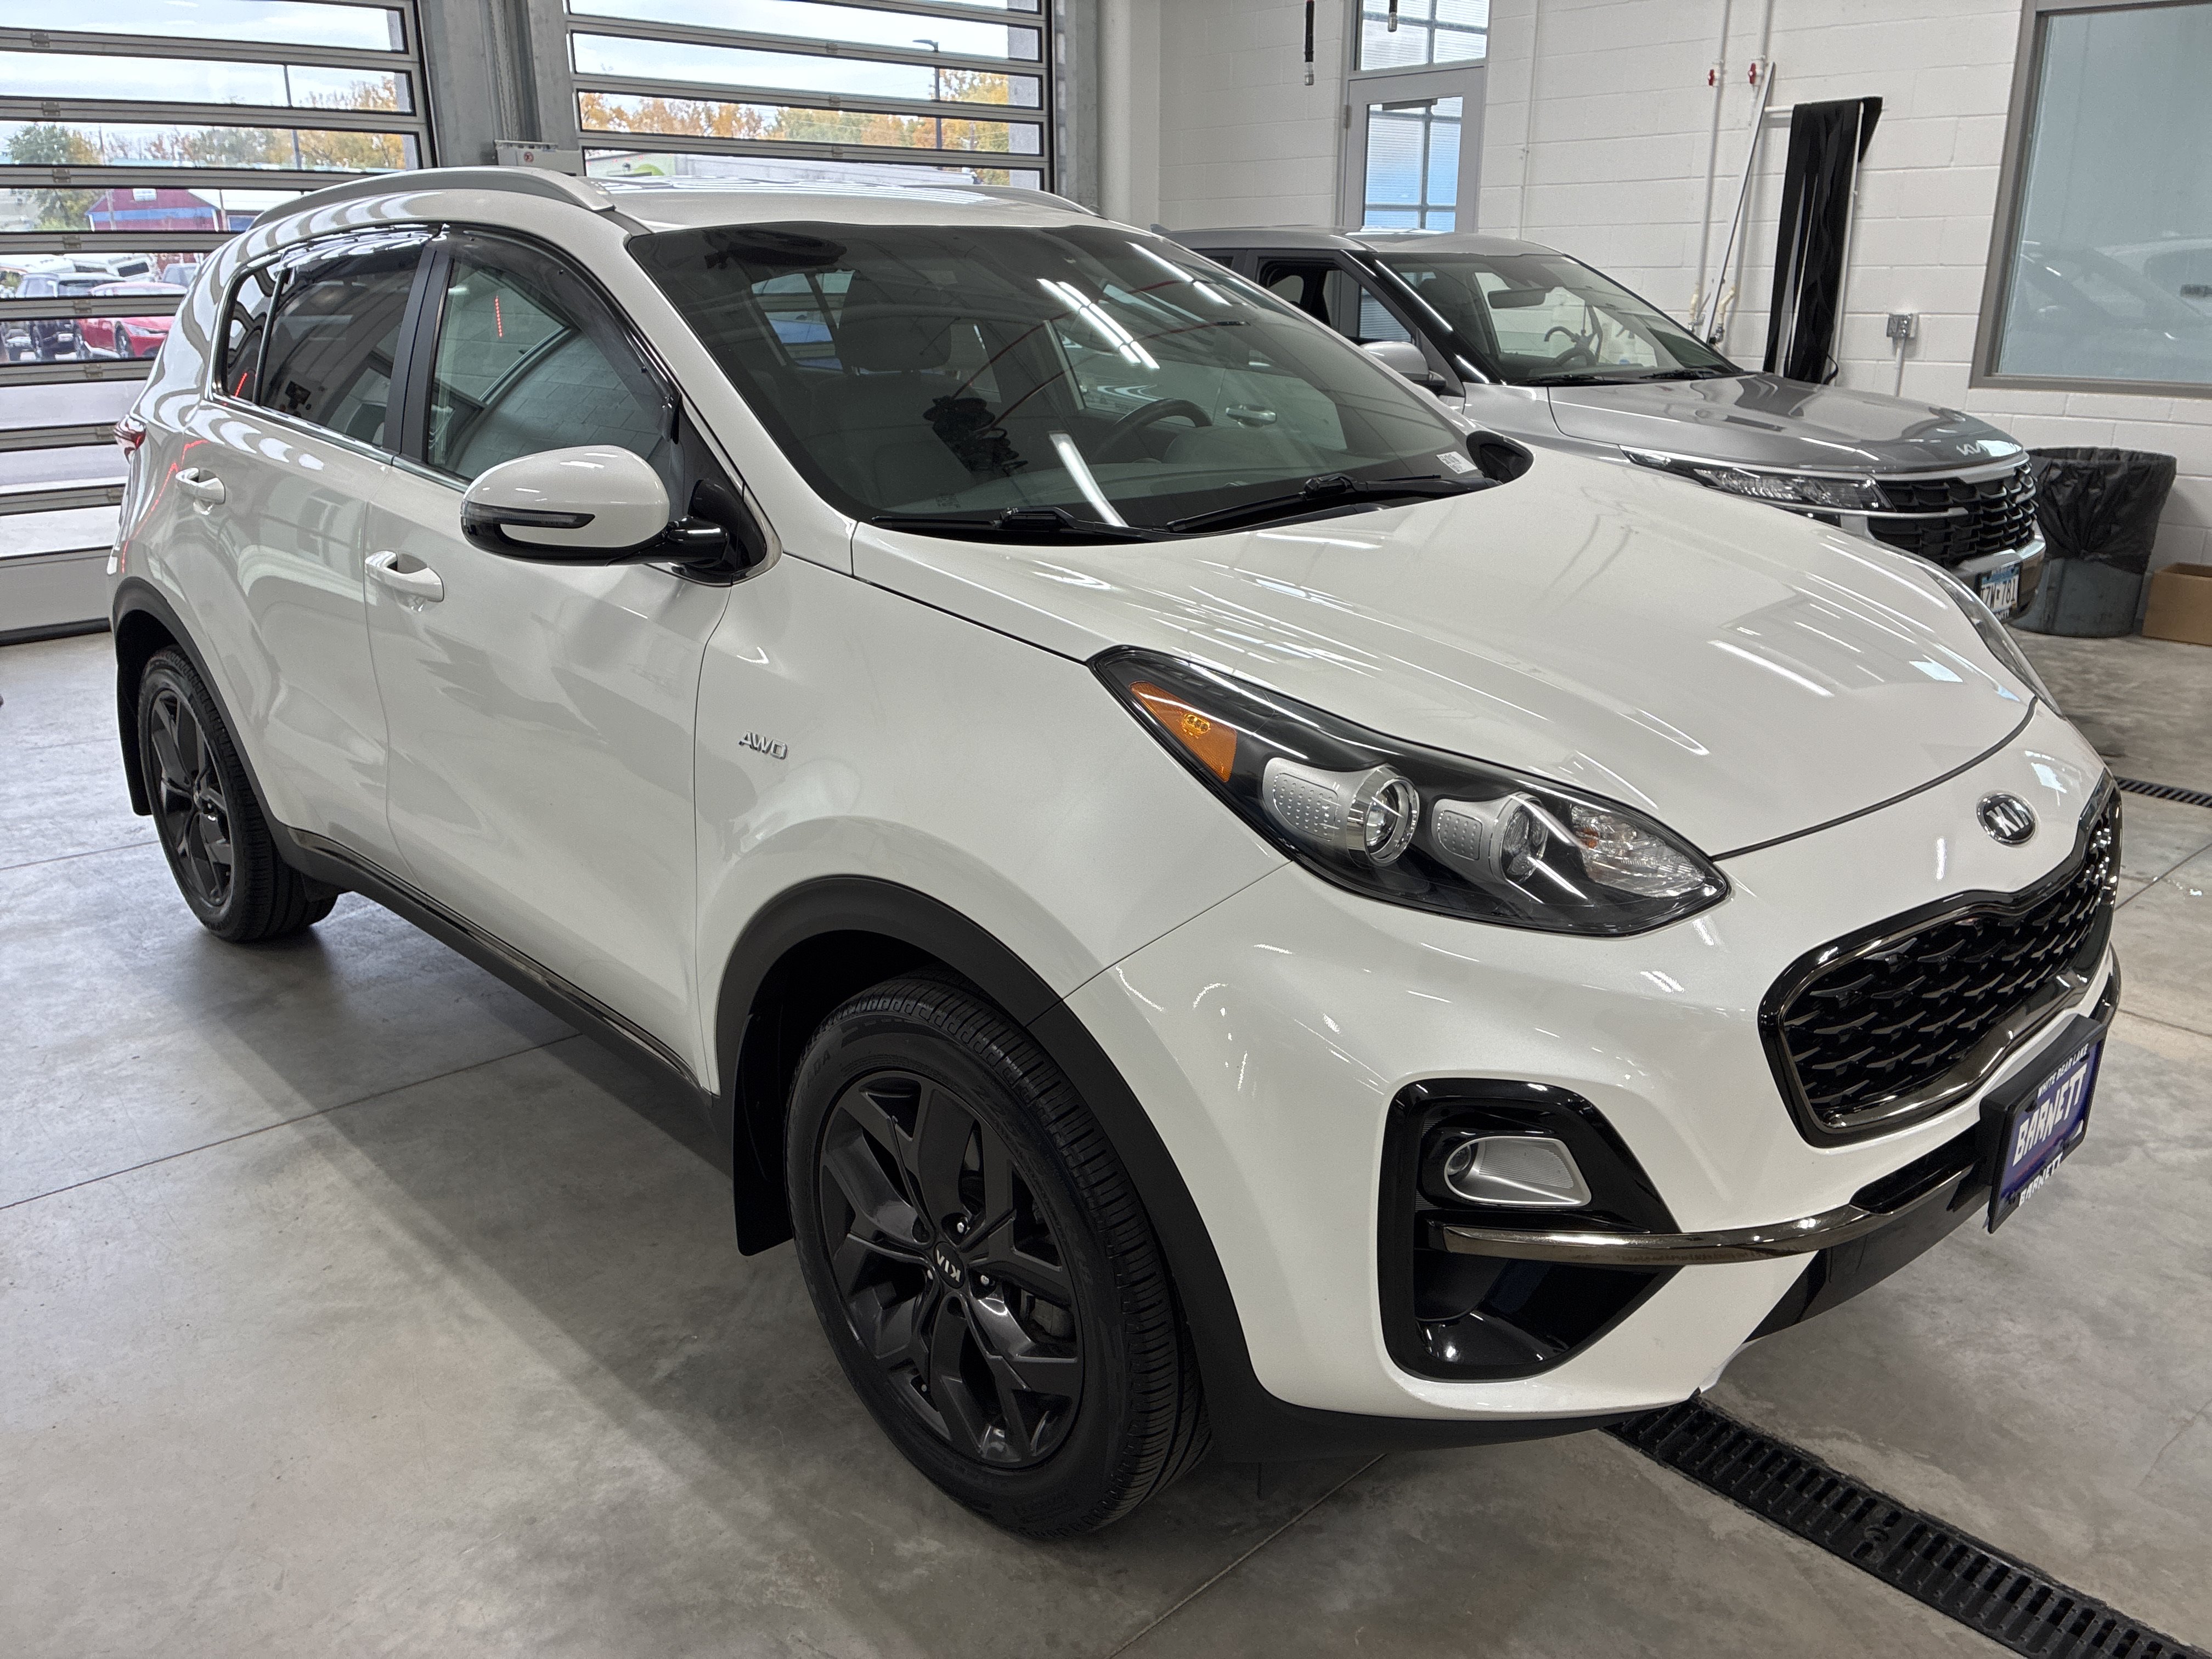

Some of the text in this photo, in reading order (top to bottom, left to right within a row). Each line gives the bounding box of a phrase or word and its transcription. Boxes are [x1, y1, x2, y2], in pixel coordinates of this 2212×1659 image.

[738, 731, 788, 760] AWD
[1985, 798, 2033, 837] KIA
[2038, 1043, 2089, 1099] WHITE BEAR LAKE
[2013, 1063, 2087, 1167] BARNETT
[2019, 1151, 2063, 1207] BARNETT
[936, 1249, 961, 1282] KIA
